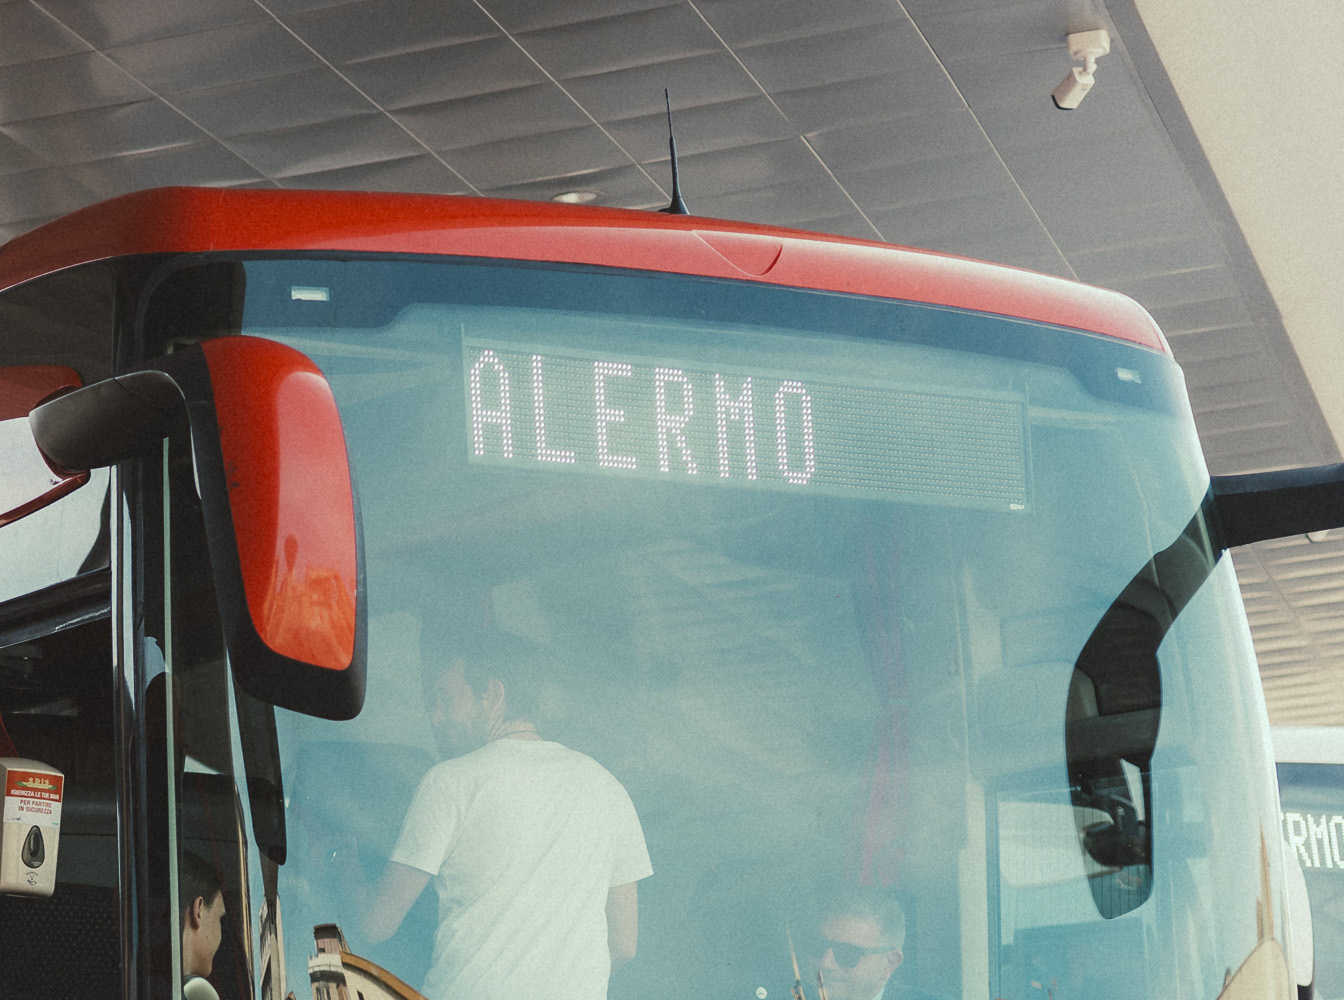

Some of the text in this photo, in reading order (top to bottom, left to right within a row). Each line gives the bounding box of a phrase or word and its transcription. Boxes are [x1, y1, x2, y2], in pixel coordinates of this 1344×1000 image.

[470, 349, 815, 485] ALERMO
[25, 806, 53, 815] SICUREZZA
[31, 800, 52, 808] PARTIRE
[1280, 812, 1344, 868] RMO
